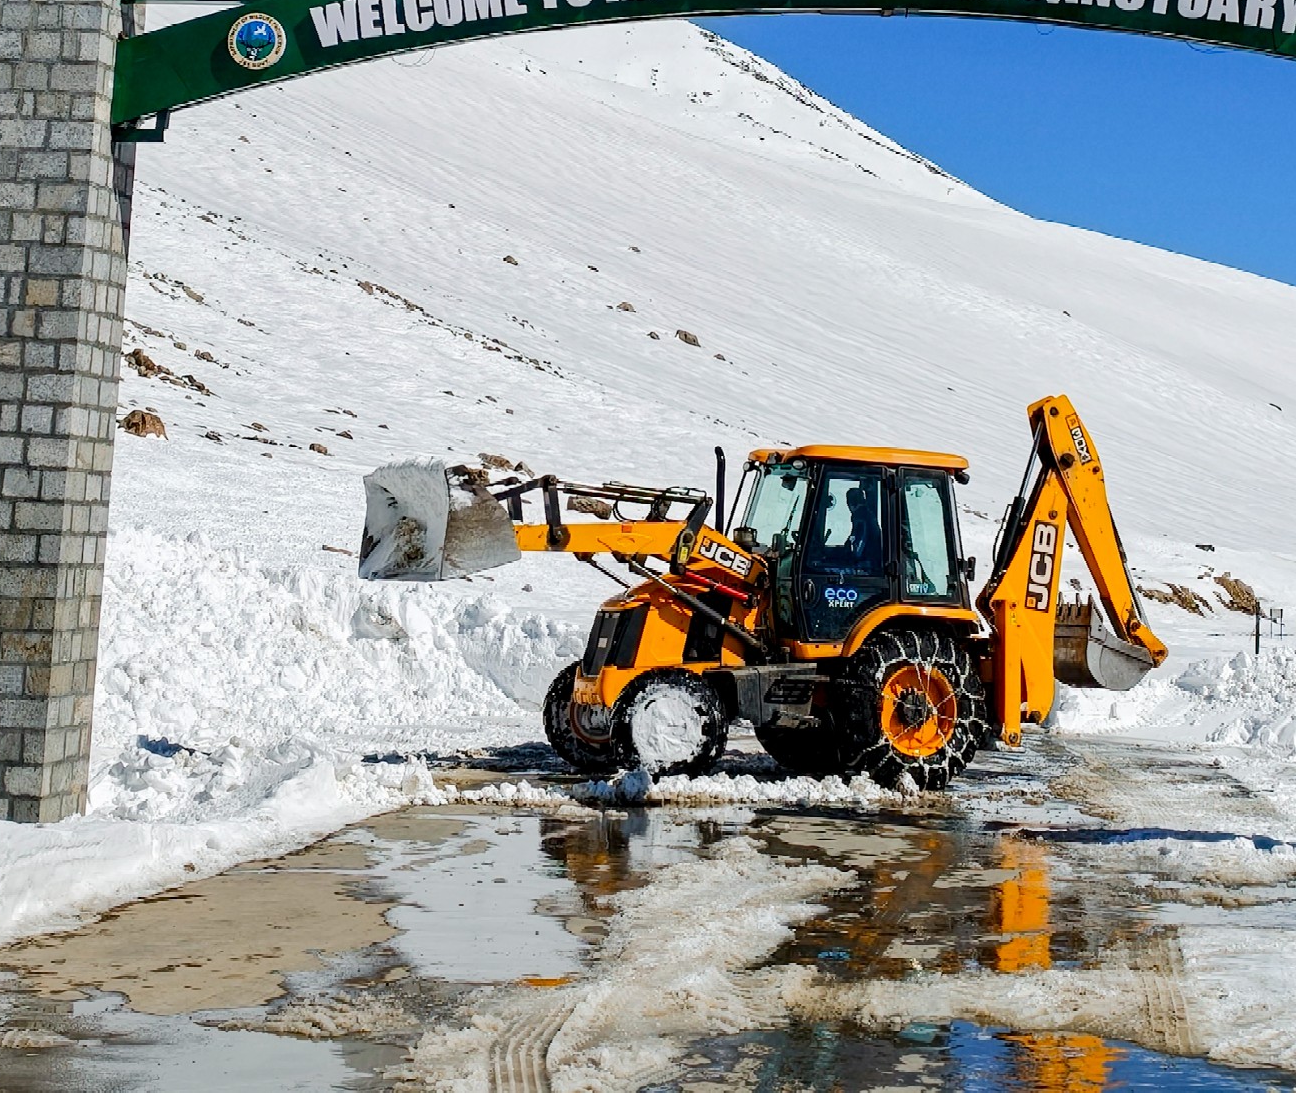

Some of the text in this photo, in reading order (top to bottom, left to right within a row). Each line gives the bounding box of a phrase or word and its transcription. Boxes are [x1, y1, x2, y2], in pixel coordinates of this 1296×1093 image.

[1071, 426, 1092, 464] 3DX
[700, 539, 752, 576] JCB
[1026, 523, 1057, 610] JCB
[825, 588, 857, 600] eco
[828, 599, 854, 608] XPERT
